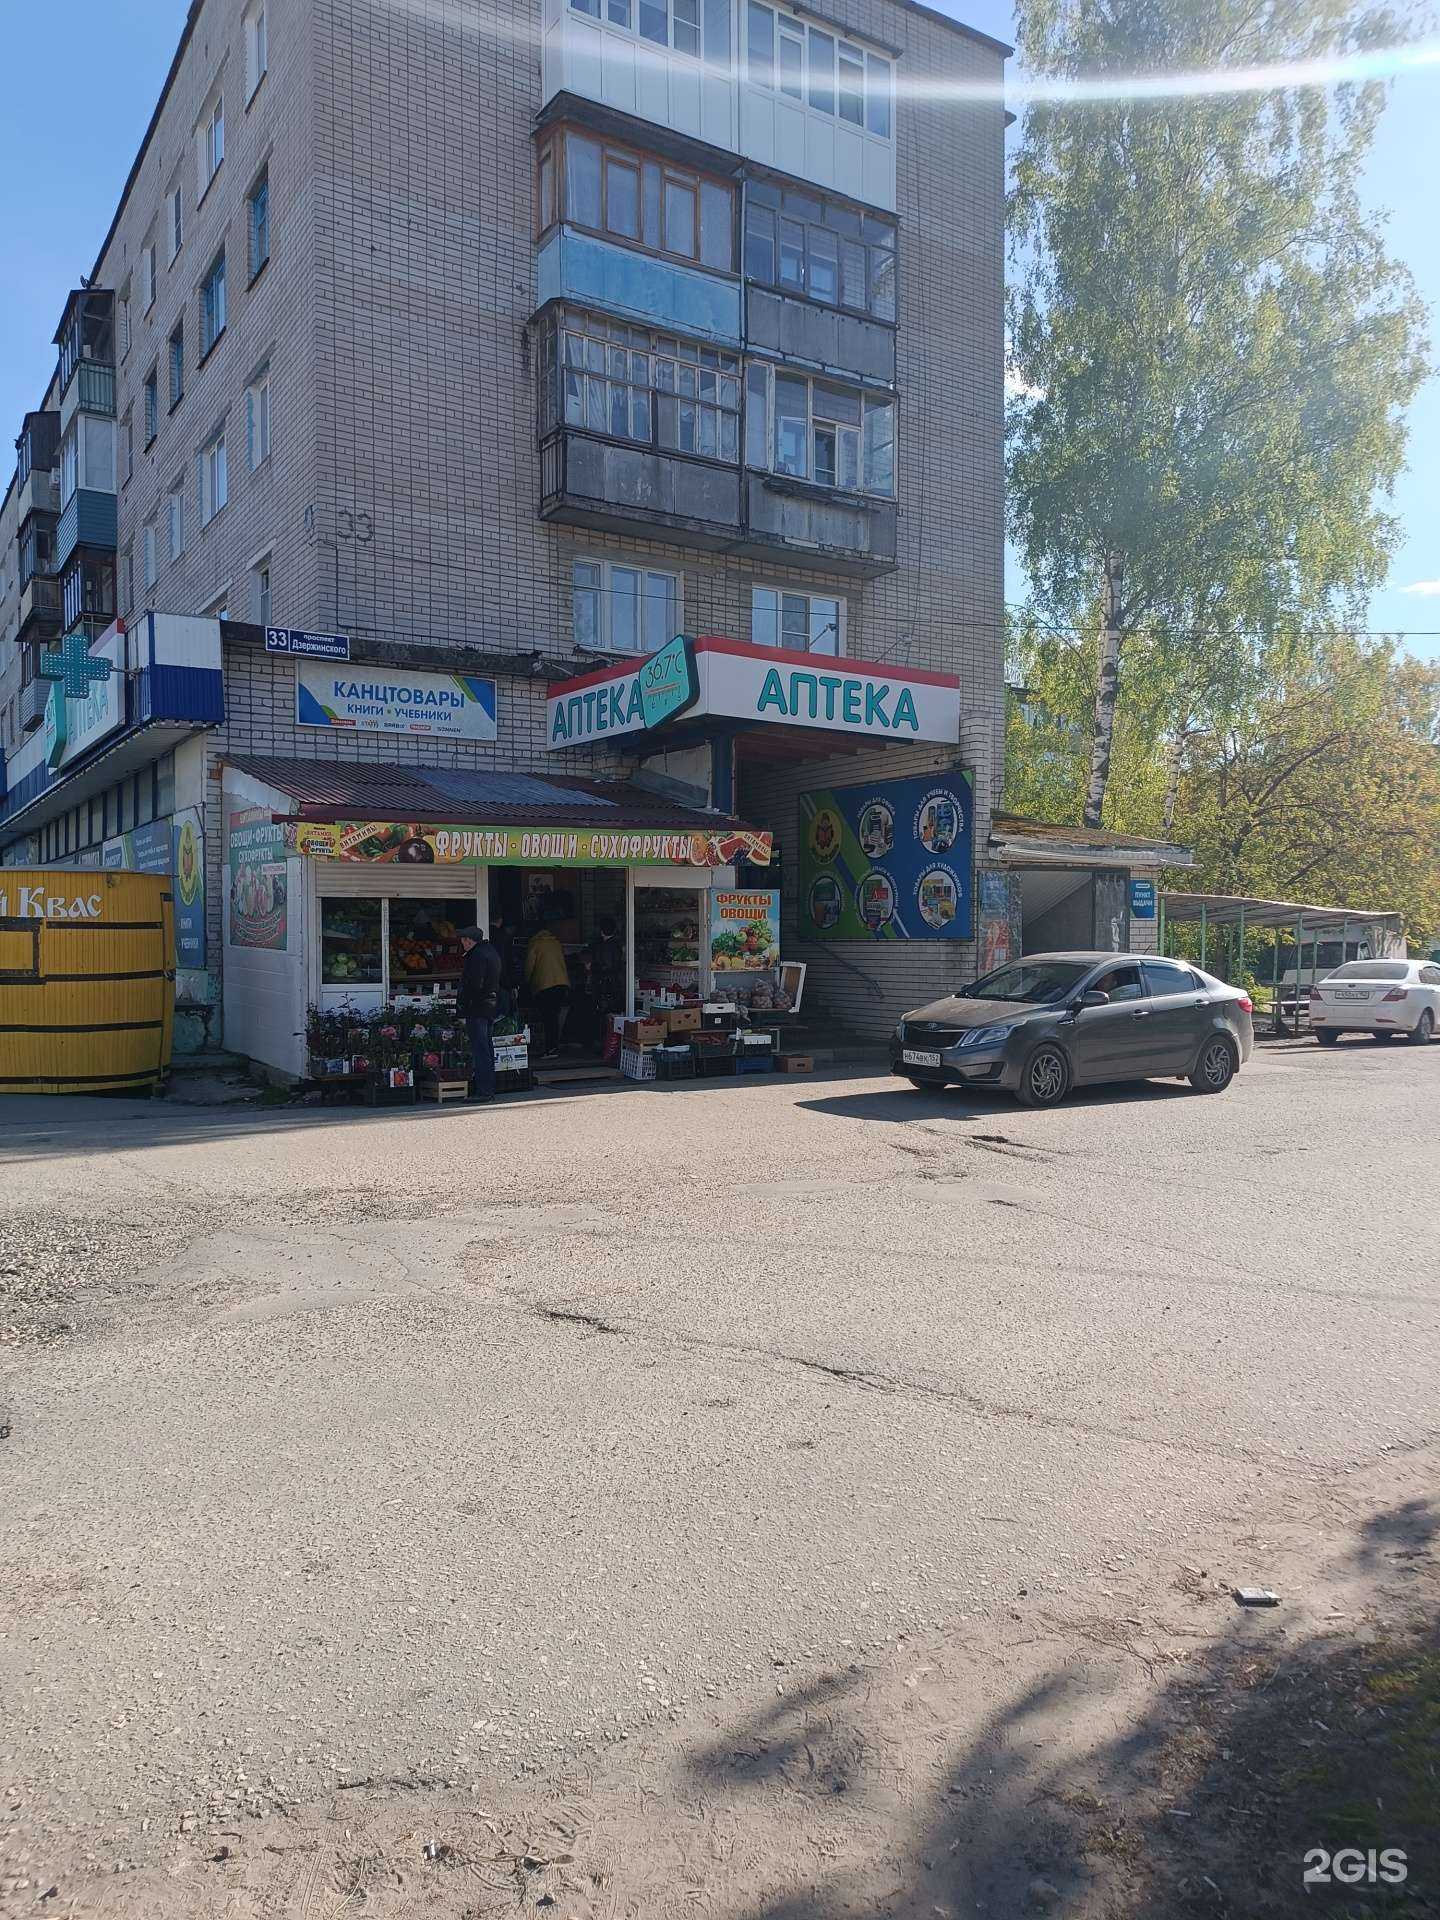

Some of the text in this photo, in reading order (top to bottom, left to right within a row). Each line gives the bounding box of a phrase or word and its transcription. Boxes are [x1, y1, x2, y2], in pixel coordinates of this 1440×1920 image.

[268, 630, 288, 647] 33
[292, 639, 347, 655] Дзержинского
[303, 633, 335, 643] проспект
[334, 680, 465, 708] КАНЦТОВАРЫ
[757, 668, 920, 732] АПТЕКА
[347, 703, 452, 721] КНИГИ УЧЕБНИКИ
[552, 679, 645, 743] АПТЕКА
[255, 824, 284, 845] ФРУКТЫ
[435, 831, 693, 860] ФРУКТЫ ОВОЩИ СУХОФРУКТЫ
[716, 893, 772, 906] ФРУКТЫ
[720, 907, 767, 921] ОВОЩИ
